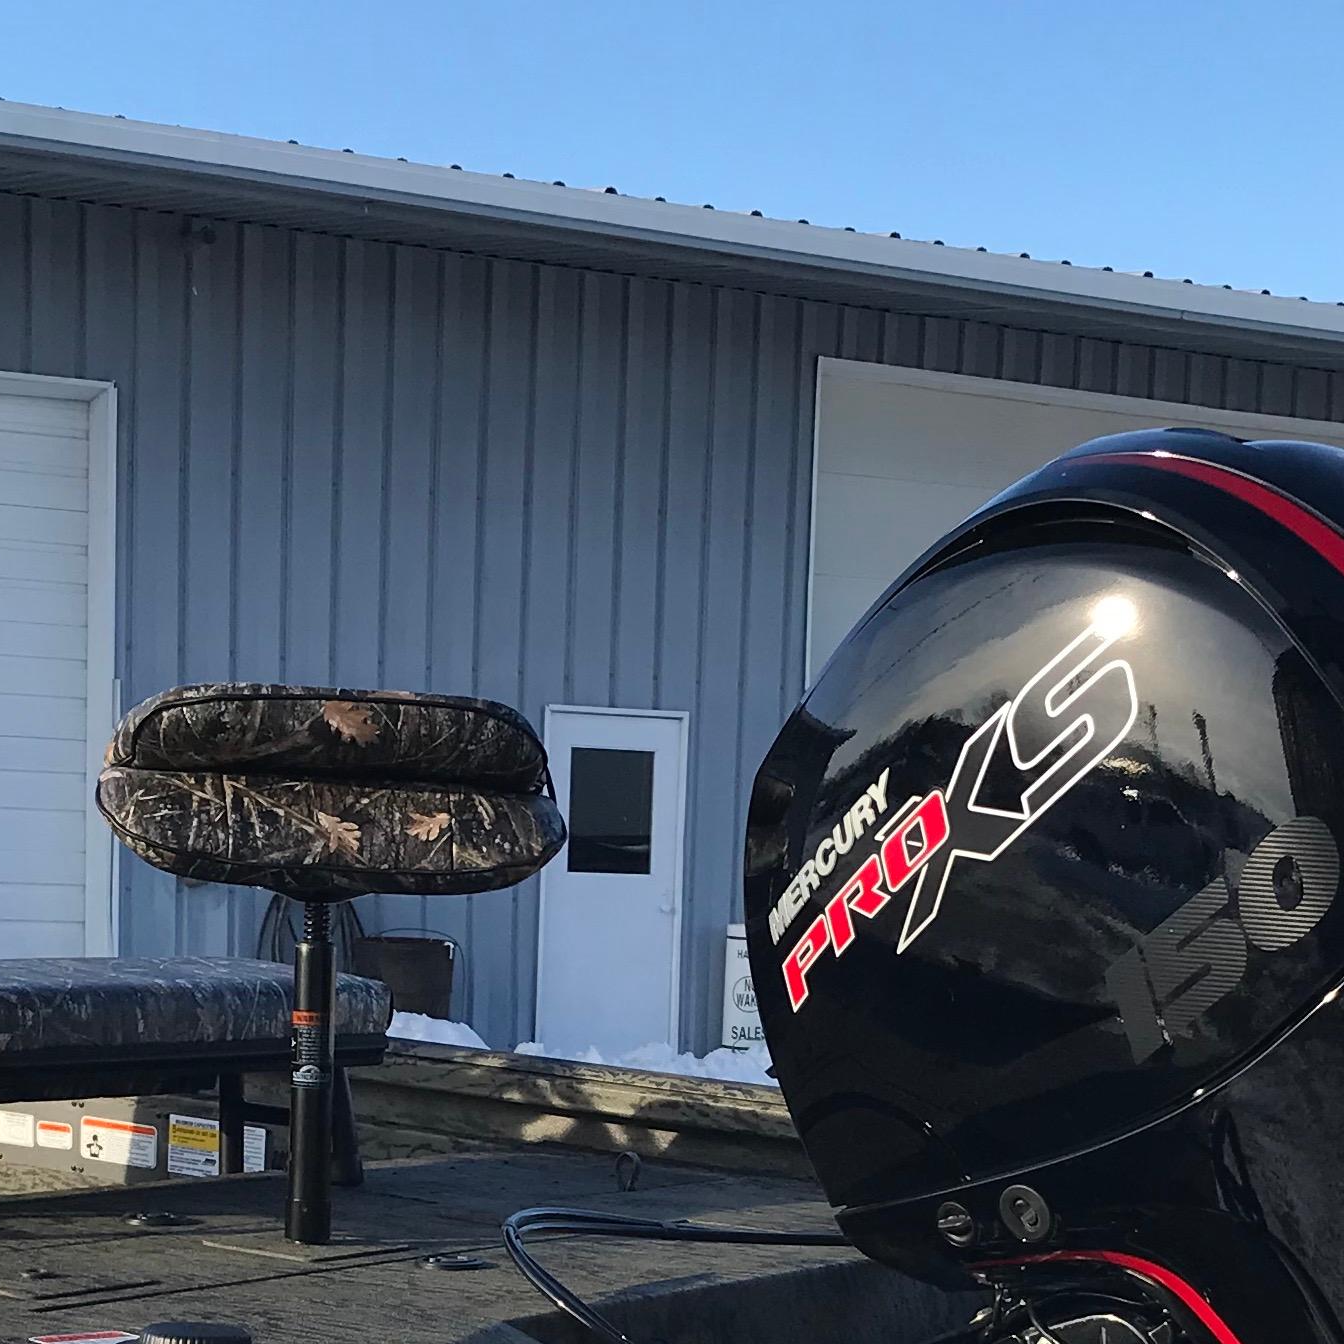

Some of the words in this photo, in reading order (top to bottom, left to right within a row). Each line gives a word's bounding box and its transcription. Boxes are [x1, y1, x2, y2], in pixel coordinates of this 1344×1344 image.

[768, 767, 889, 945] MERCURY
[782, 789, 950, 1013] PRO
[888, 610, 1139, 956] XS
[1105, 816, 1340, 1066] 150
